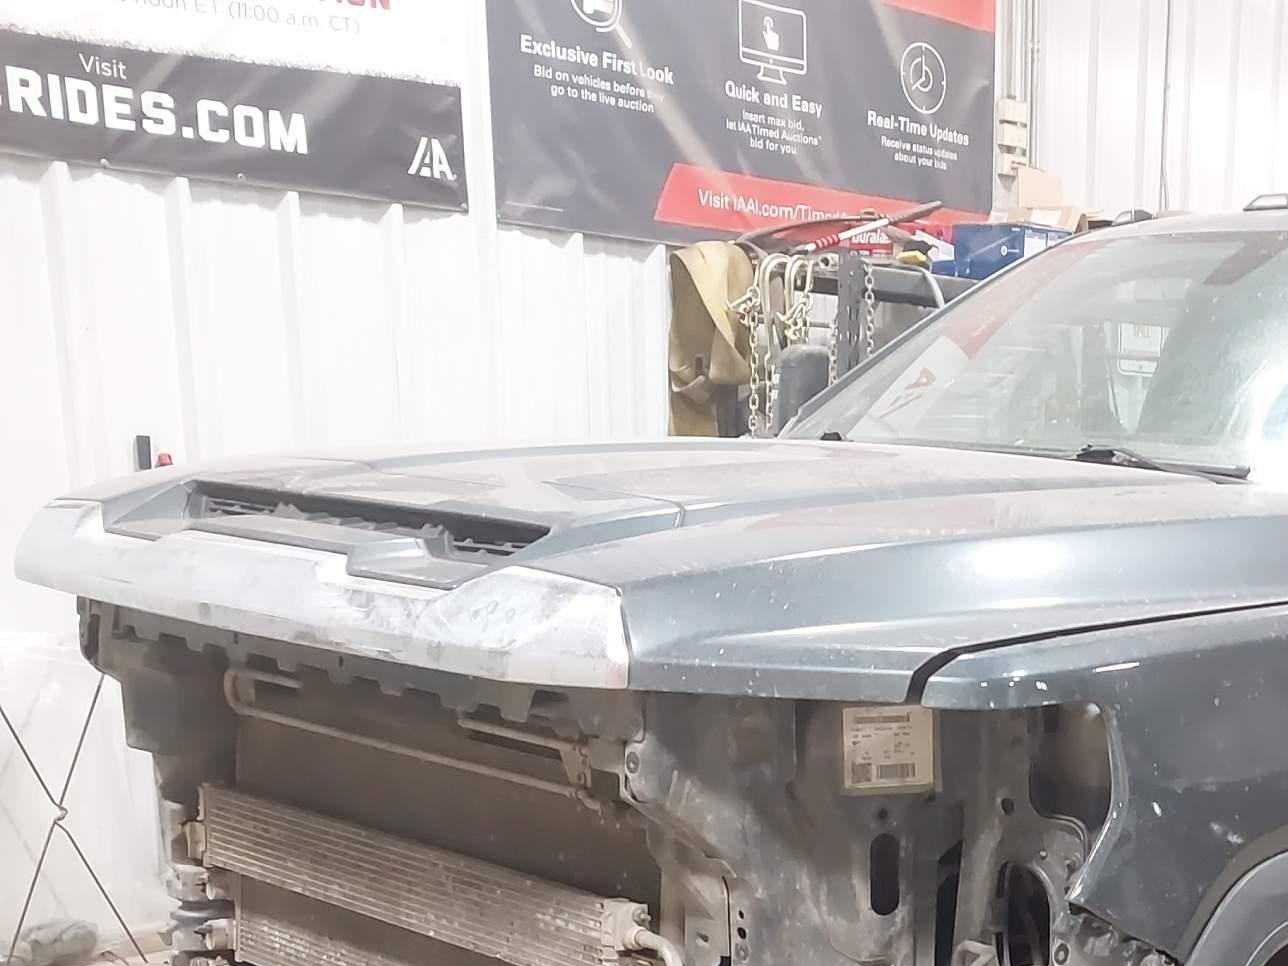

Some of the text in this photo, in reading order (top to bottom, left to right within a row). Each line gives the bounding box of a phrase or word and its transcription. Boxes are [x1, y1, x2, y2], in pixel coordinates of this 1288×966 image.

[228, 1, 280, 23] (11:00
[329, 15, 361, 36] CT)
[79, 52, 127, 79] Visit
[520, 33, 674, 85] Exclusive First Look
[533, 64, 552, 79] Bid
[555, 70, 569, 82] on
[571, 73, 611, 91] vehicles
[613, 80, 645, 97] before
[0, 65, 309, 155] RIDES.COM
[550, 85, 655, 113] go to the live auction
[725, 80, 823, 119] Quick and Easy
[726, 118, 737, 130] let
[742, 108, 766, 123] Insert
[767, 115, 786, 128] max
[867, 110, 969, 146] Real-Time Updates
[750, 136, 797, 154] bid for you
[881, 135, 911, 151] Receive
[912, 143, 933, 155] status
[894, 152, 948, 170] about your bids
[698, 188, 730, 210] Visit
